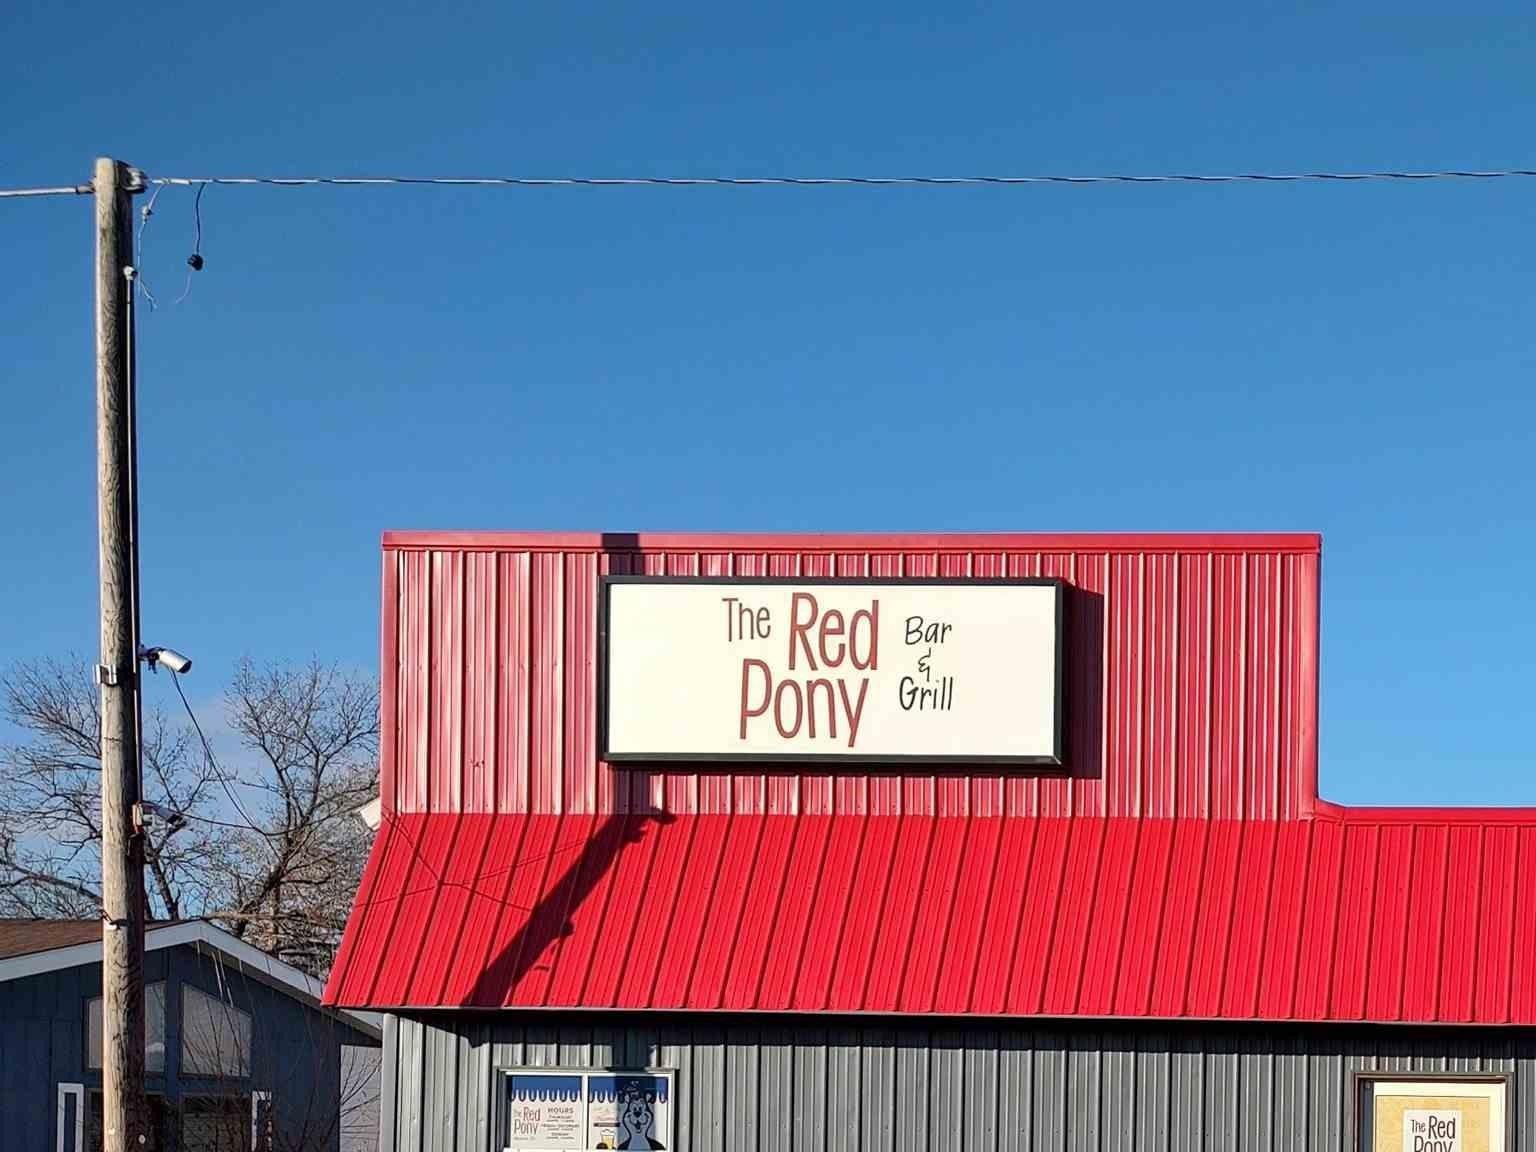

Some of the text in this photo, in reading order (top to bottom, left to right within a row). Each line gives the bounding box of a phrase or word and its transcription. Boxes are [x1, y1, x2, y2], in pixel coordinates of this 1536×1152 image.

[722, 592, 880, 671] The Red
[904, 615, 953, 646] Bar
[918, 647, 931, 682] &
[739, 658, 870, 748] Pony
[898, 675, 954, 711] Grill
[514, 1119, 539, 1135] Pony
[523, 1106, 541, 1121] Red
[1410, 1115, 1455, 1139] The Red
